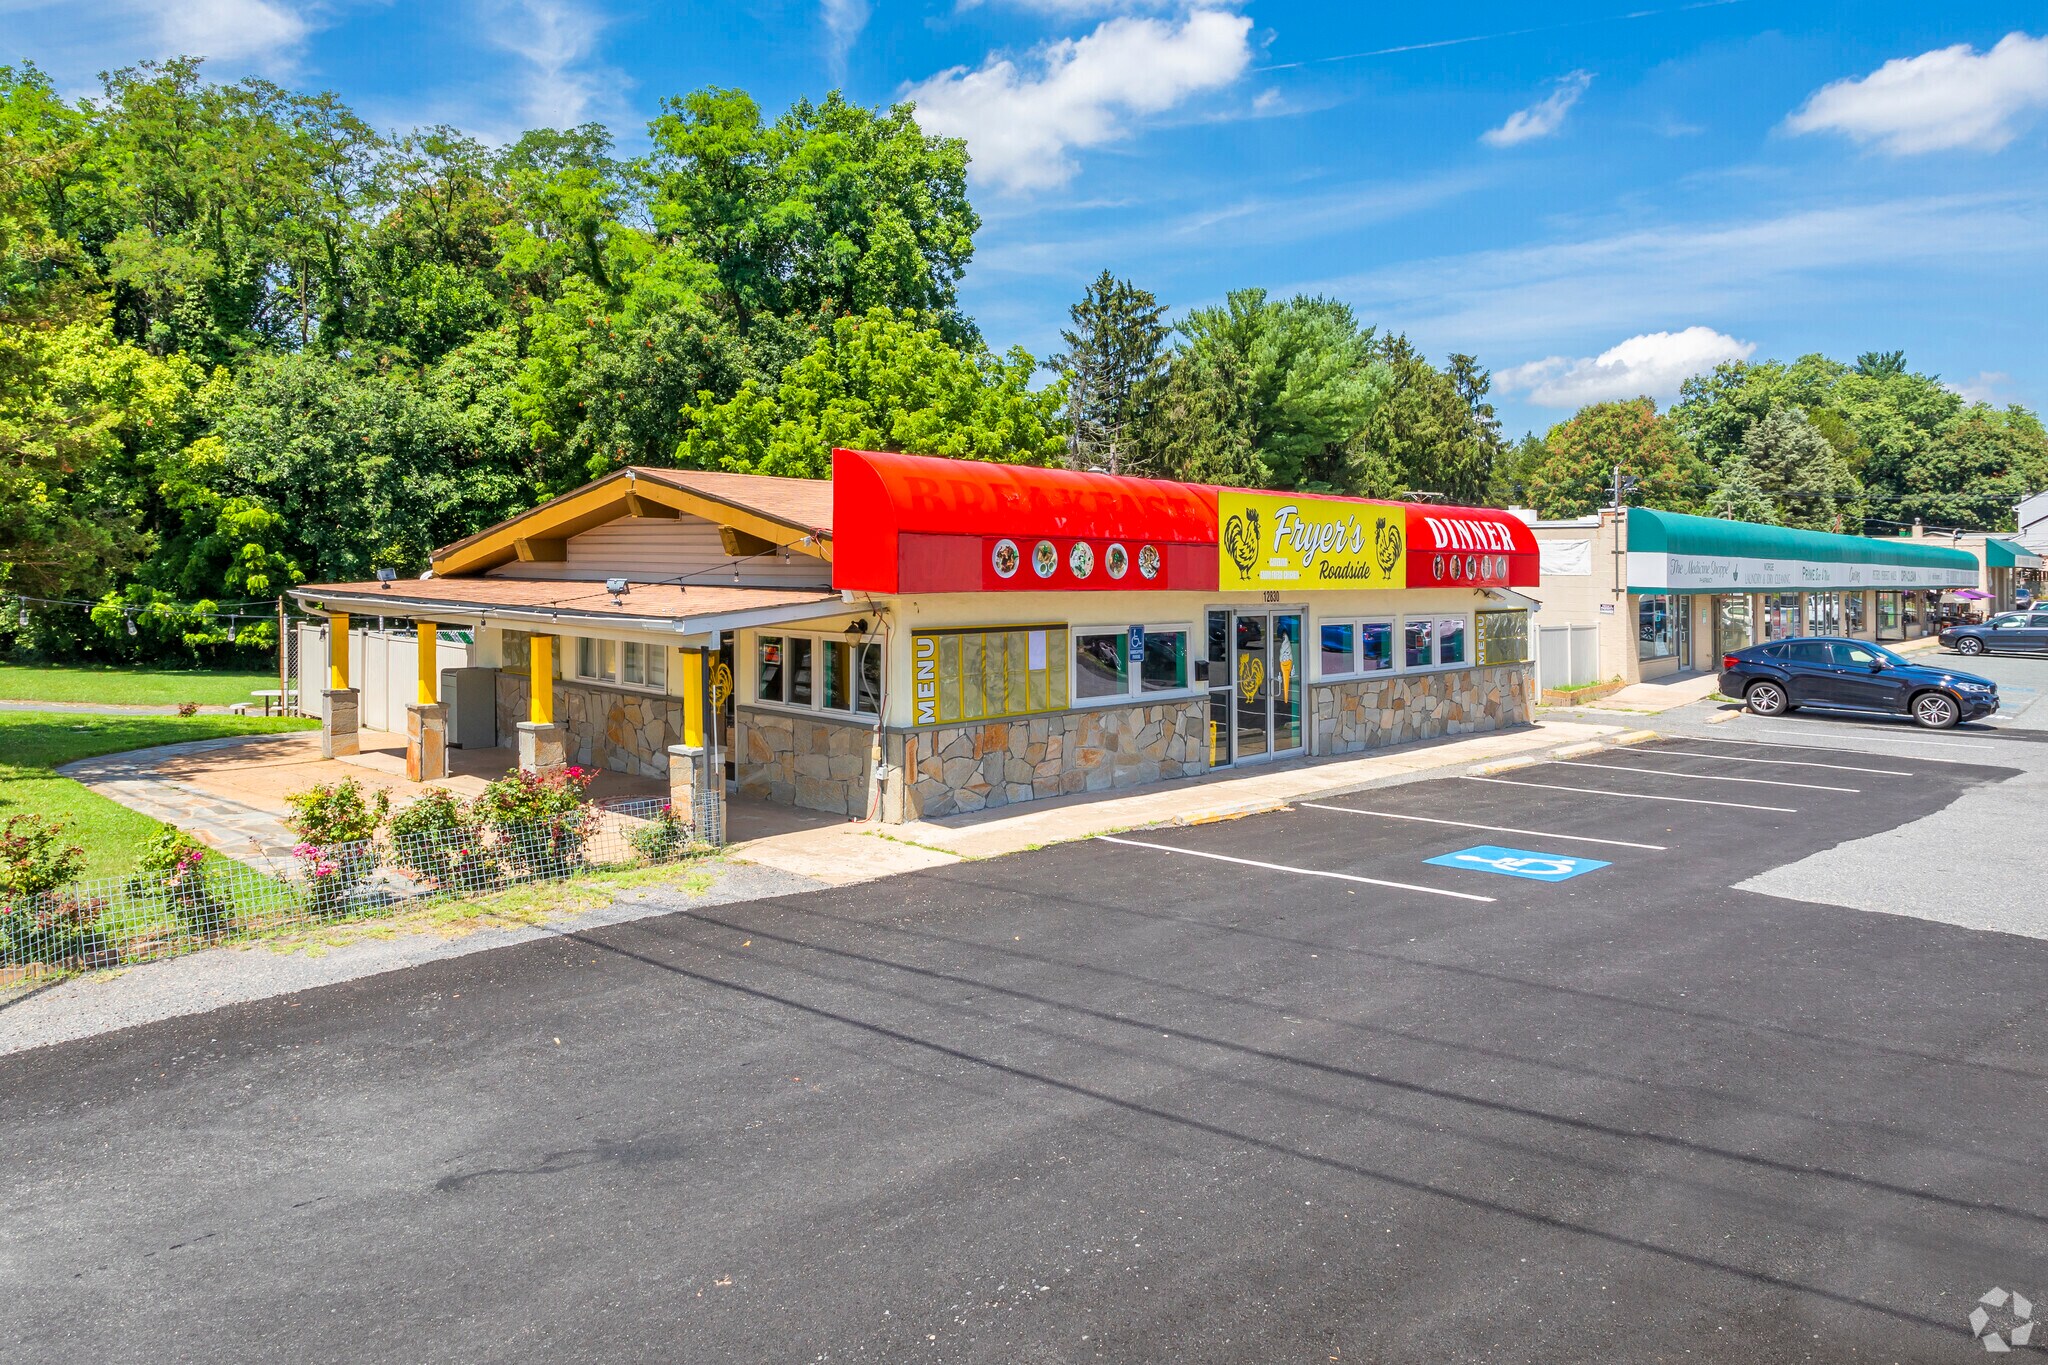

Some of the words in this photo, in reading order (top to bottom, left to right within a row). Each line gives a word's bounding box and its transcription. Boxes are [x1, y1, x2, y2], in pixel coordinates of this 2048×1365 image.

[1272, 505, 1365, 567] Fryer's
[1425, 516, 1516, 551] DINNER
[1319, 559, 1371, 581] Roadside
[1670, 558, 1684, 576] The
[1685, 559, 1711, 576] Medicine
[1263, 591, 1280, 602] 12830
[1478, 614, 1486, 666] MENU
[916, 637, 936, 724] MENU
